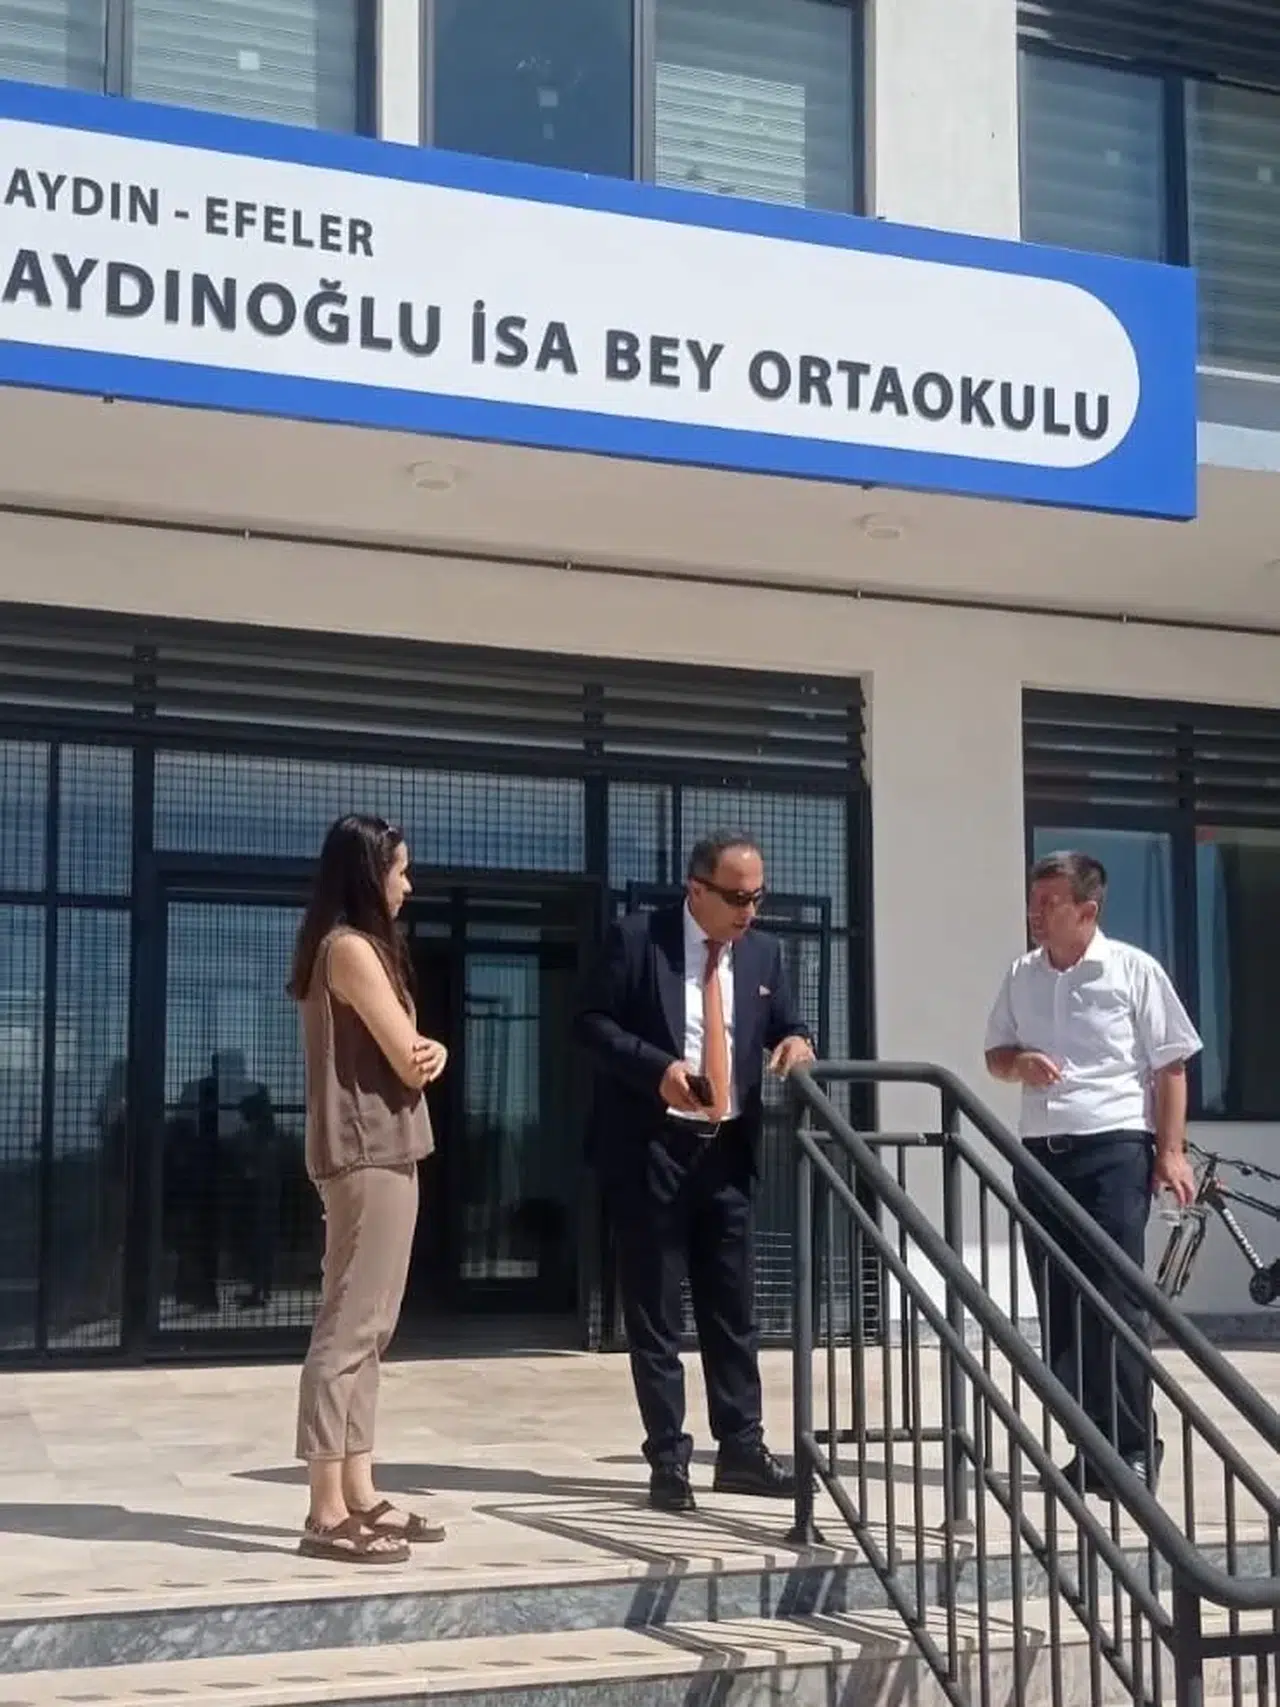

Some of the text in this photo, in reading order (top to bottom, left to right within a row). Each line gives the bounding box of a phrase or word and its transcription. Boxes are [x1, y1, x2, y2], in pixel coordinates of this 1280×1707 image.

[3, 167, 159, 226] AYDIN
[206, 196, 374, 258] EFELER
[2, 248, 1110, 441] AYDINOĞLU İSA BEY ORTAOKULU
